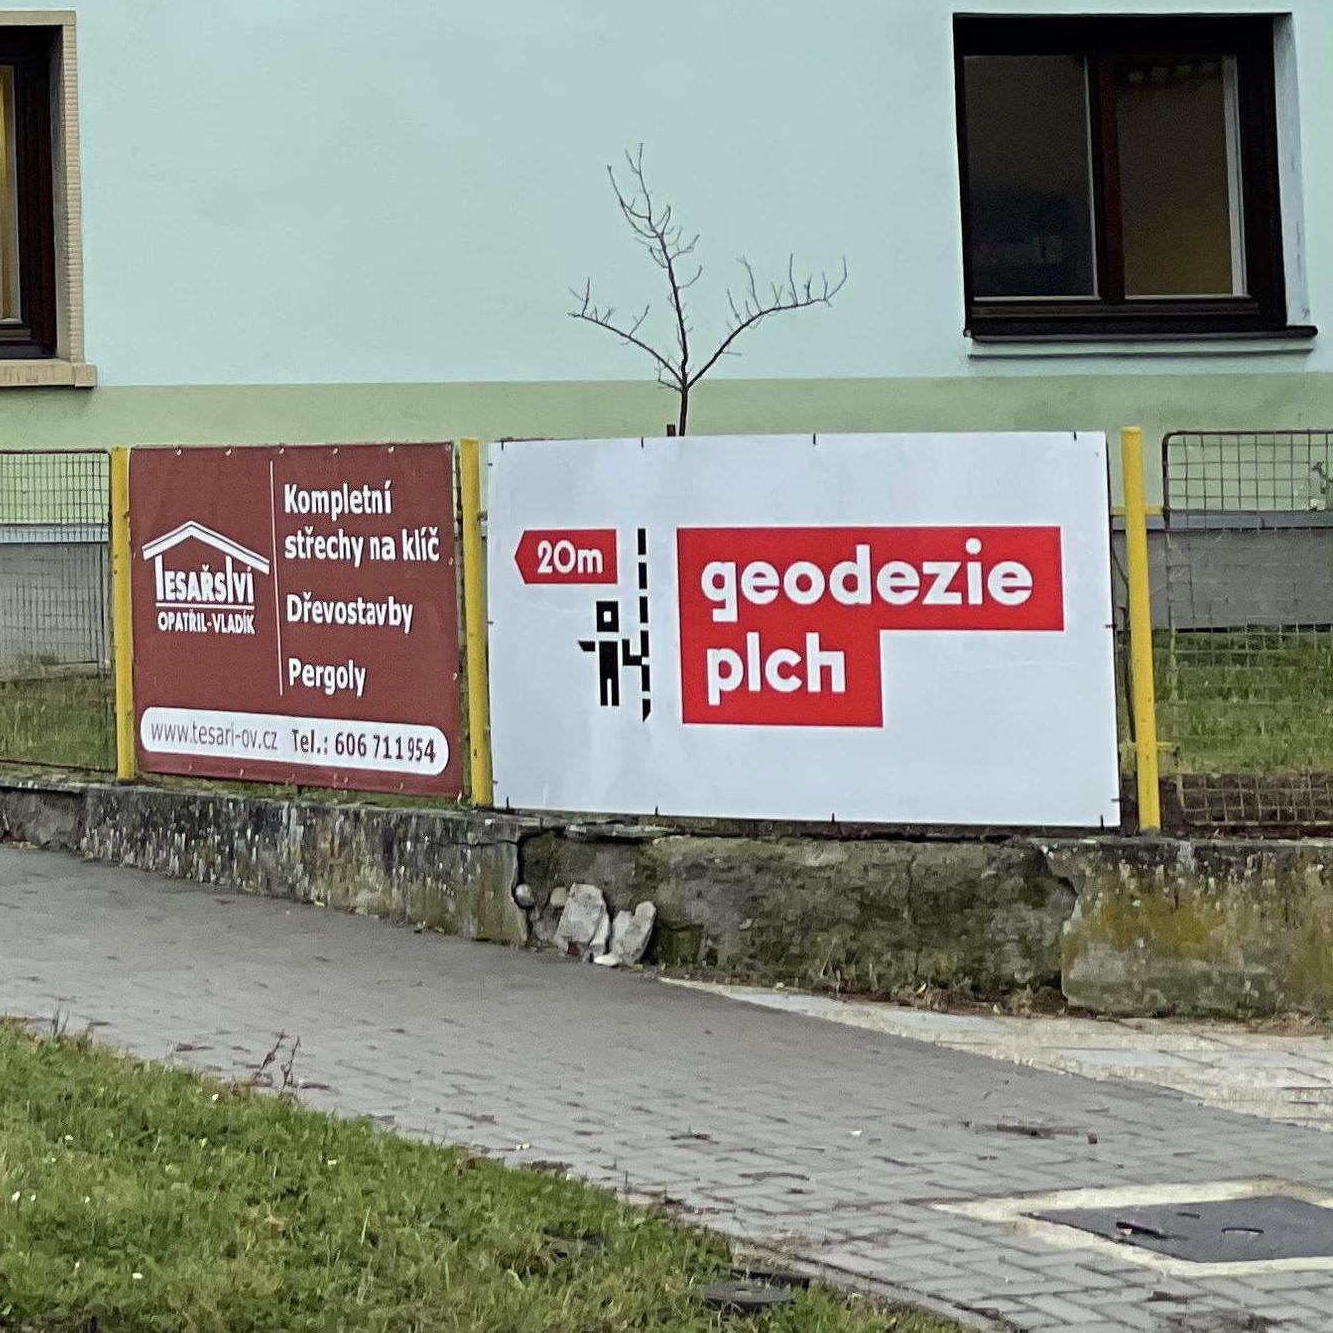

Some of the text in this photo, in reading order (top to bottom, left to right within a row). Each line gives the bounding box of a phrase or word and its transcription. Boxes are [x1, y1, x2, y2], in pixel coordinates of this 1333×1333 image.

[284, 480, 392, 521] Kompletní
[284, 526, 440, 567] střechy na klíč
[537, 540, 603, 574] 20m
[701, 538, 1033, 622] geodezie
[287, 591, 413, 634] Dřevostavby
[288, 657, 366, 697] Pergoly
[707, 632, 846, 706] plch
[151, 721, 278, 750] www.tesari-ov.cz
[292, 728, 328, 755] Tel.:
[335, 732, 367, 756] 606
